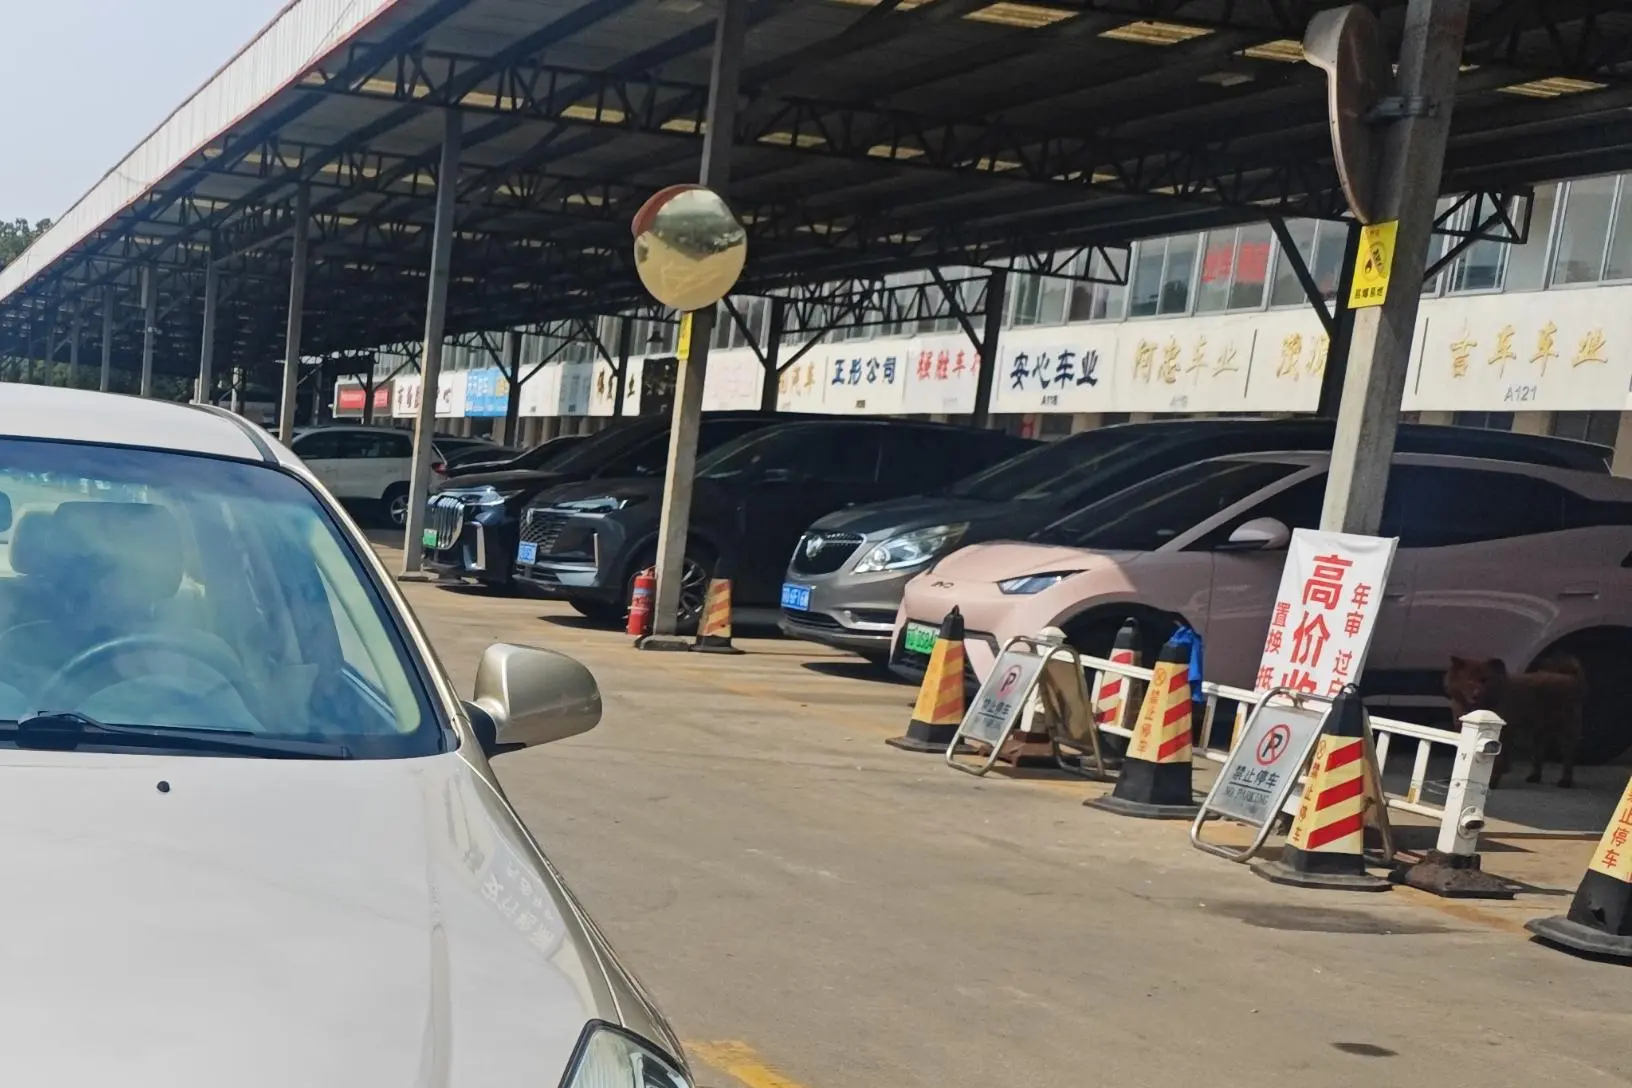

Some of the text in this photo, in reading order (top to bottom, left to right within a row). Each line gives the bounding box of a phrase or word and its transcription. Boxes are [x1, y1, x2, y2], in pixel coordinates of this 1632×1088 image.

[1010, 349, 1099, 391] 安心车业
[1504, 386, 1537, 401] A121
[1264, 601, 1291, 655] 置换
[1344, 582, 1372, 638] 年审
[1232, 765, 1280, 789] 禁止停车
